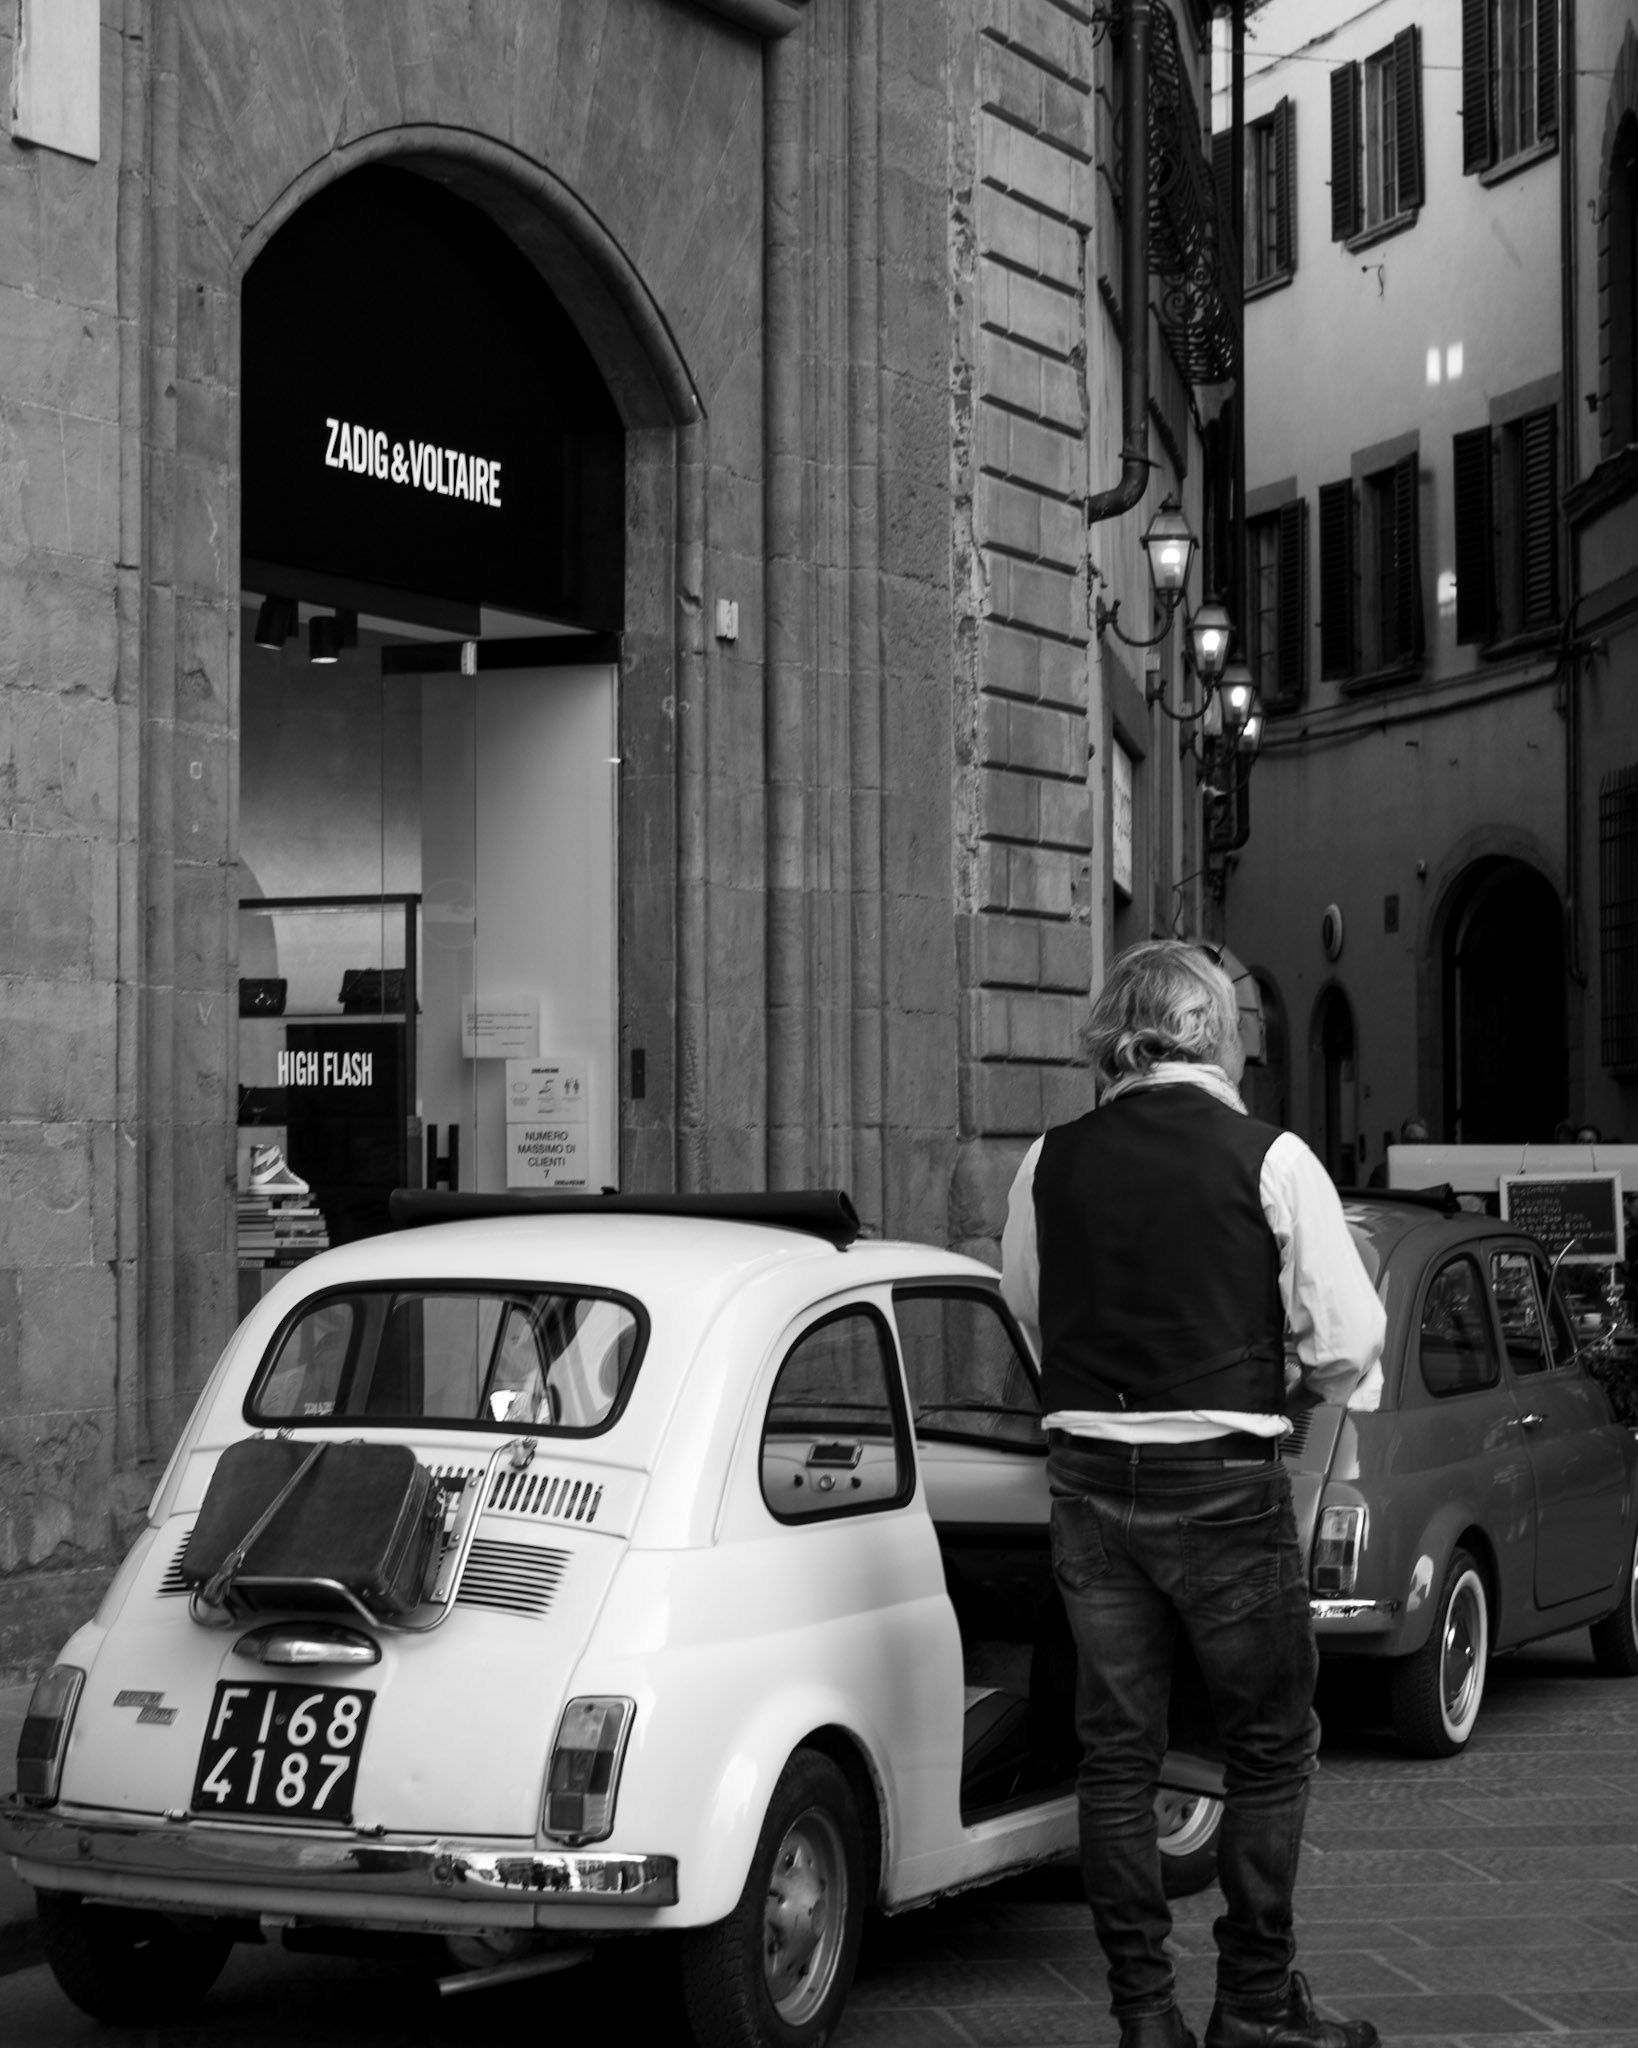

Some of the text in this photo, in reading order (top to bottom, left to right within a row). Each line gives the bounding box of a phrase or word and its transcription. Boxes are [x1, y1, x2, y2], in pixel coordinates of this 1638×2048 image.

[278, 1050, 373, 1087] HIGH FLASH
[524, 1130, 569, 1142] NUMERO
[517, 1143, 576, 1154] MASSIMO DI
[527, 1156, 566, 1168] CLIENTI
[543, 1168, 550, 1179] 7
[201, 1747, 351, 1810] 4187
